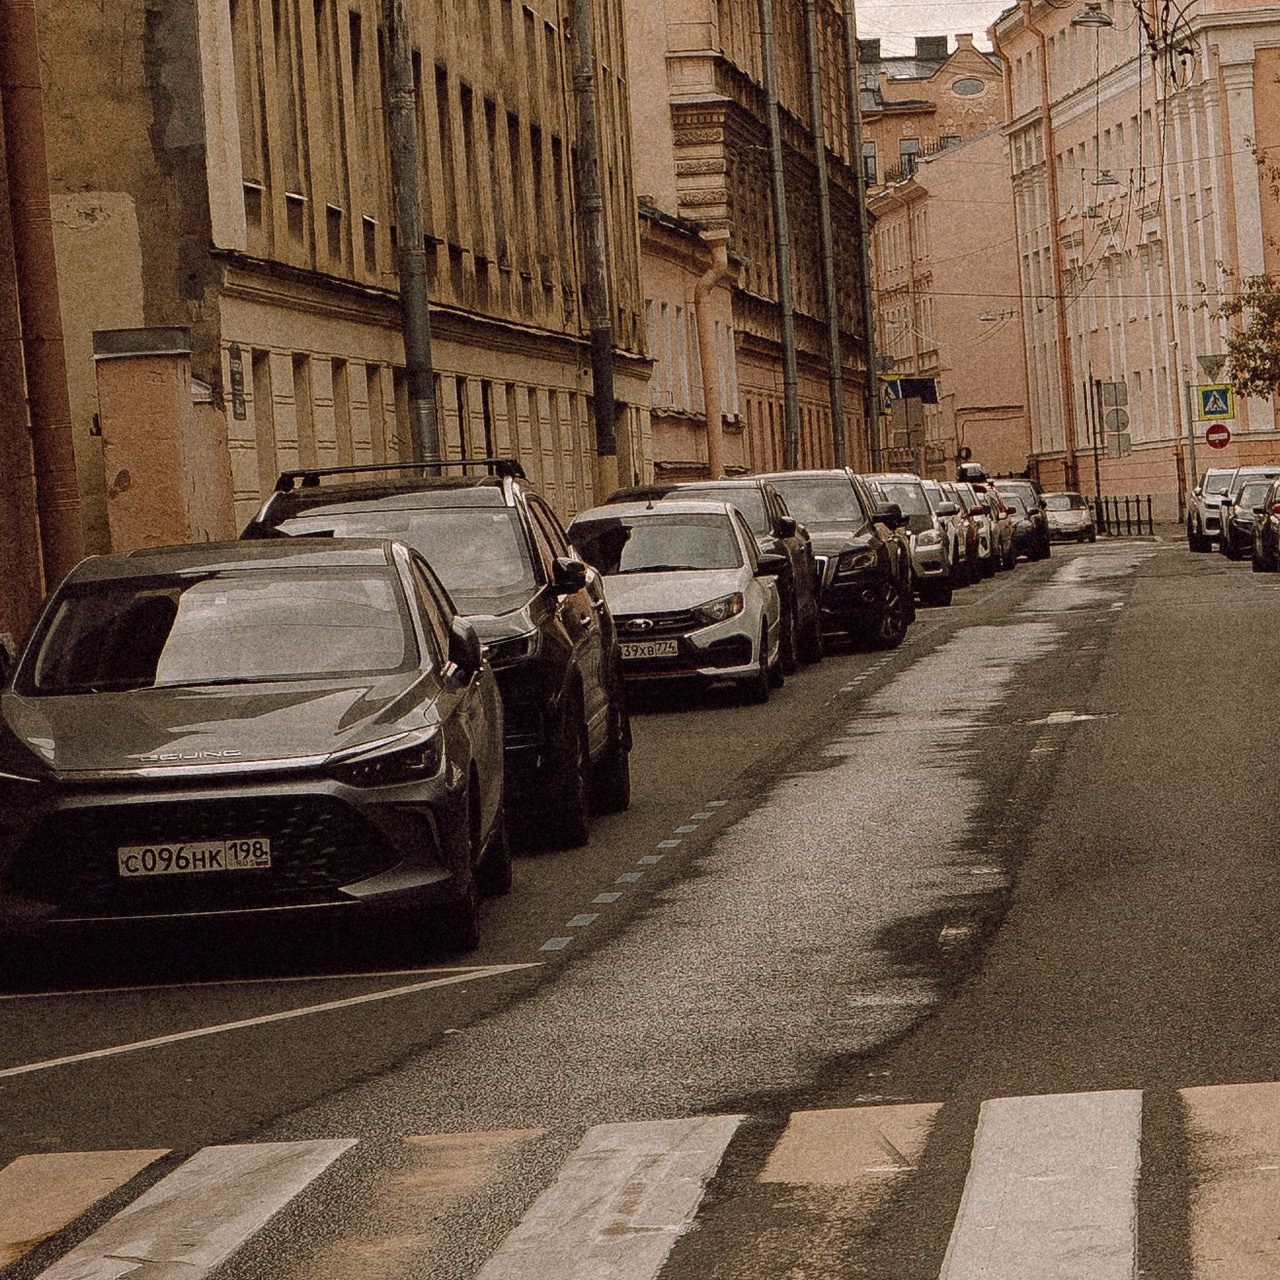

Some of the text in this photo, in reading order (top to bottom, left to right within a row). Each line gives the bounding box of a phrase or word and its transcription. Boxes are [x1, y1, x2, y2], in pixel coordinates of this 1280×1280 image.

[622, 644, 655, 657] 39ХВ
[123, 841, 266, 873] С096НК 198
